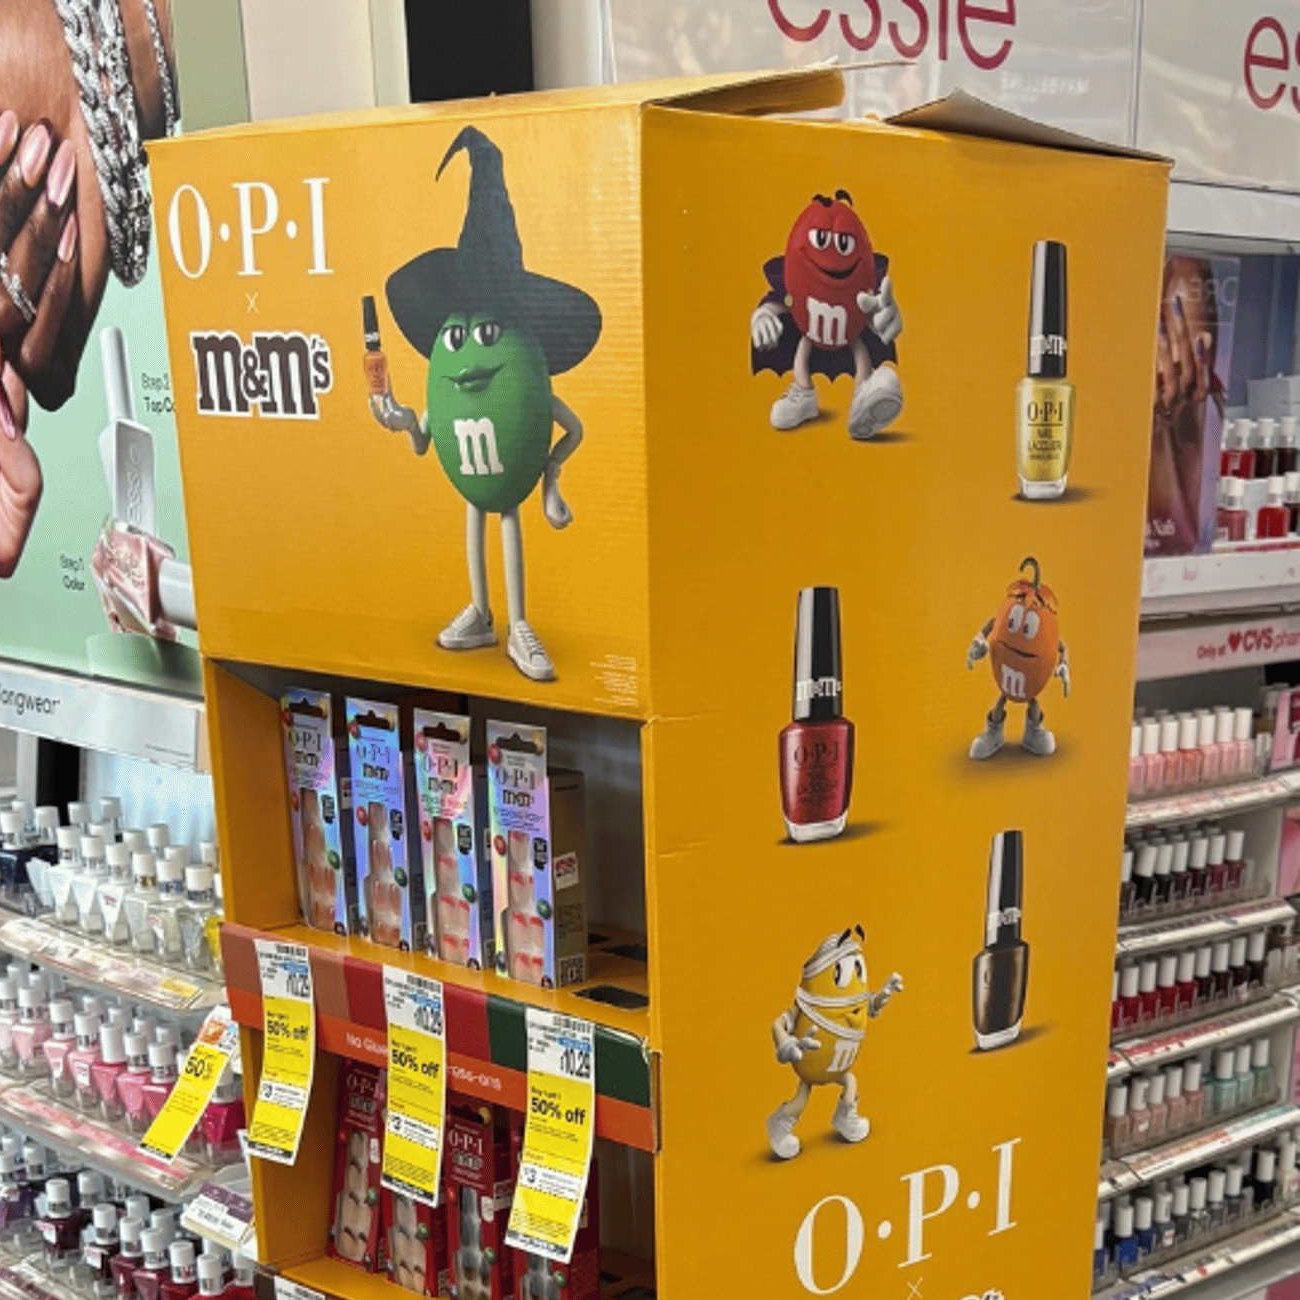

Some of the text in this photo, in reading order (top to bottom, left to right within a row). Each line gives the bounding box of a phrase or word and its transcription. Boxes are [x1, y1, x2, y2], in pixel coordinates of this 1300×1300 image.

[806, 296, 848, 347] m
[453, 417, 504, 475] m
[1000, 663, 1027, 699] m
[392, 1048, 419, 1073] 50%
[826, 1039, 861, 1073] m
[531, 1098, 561, 1120] 50%
